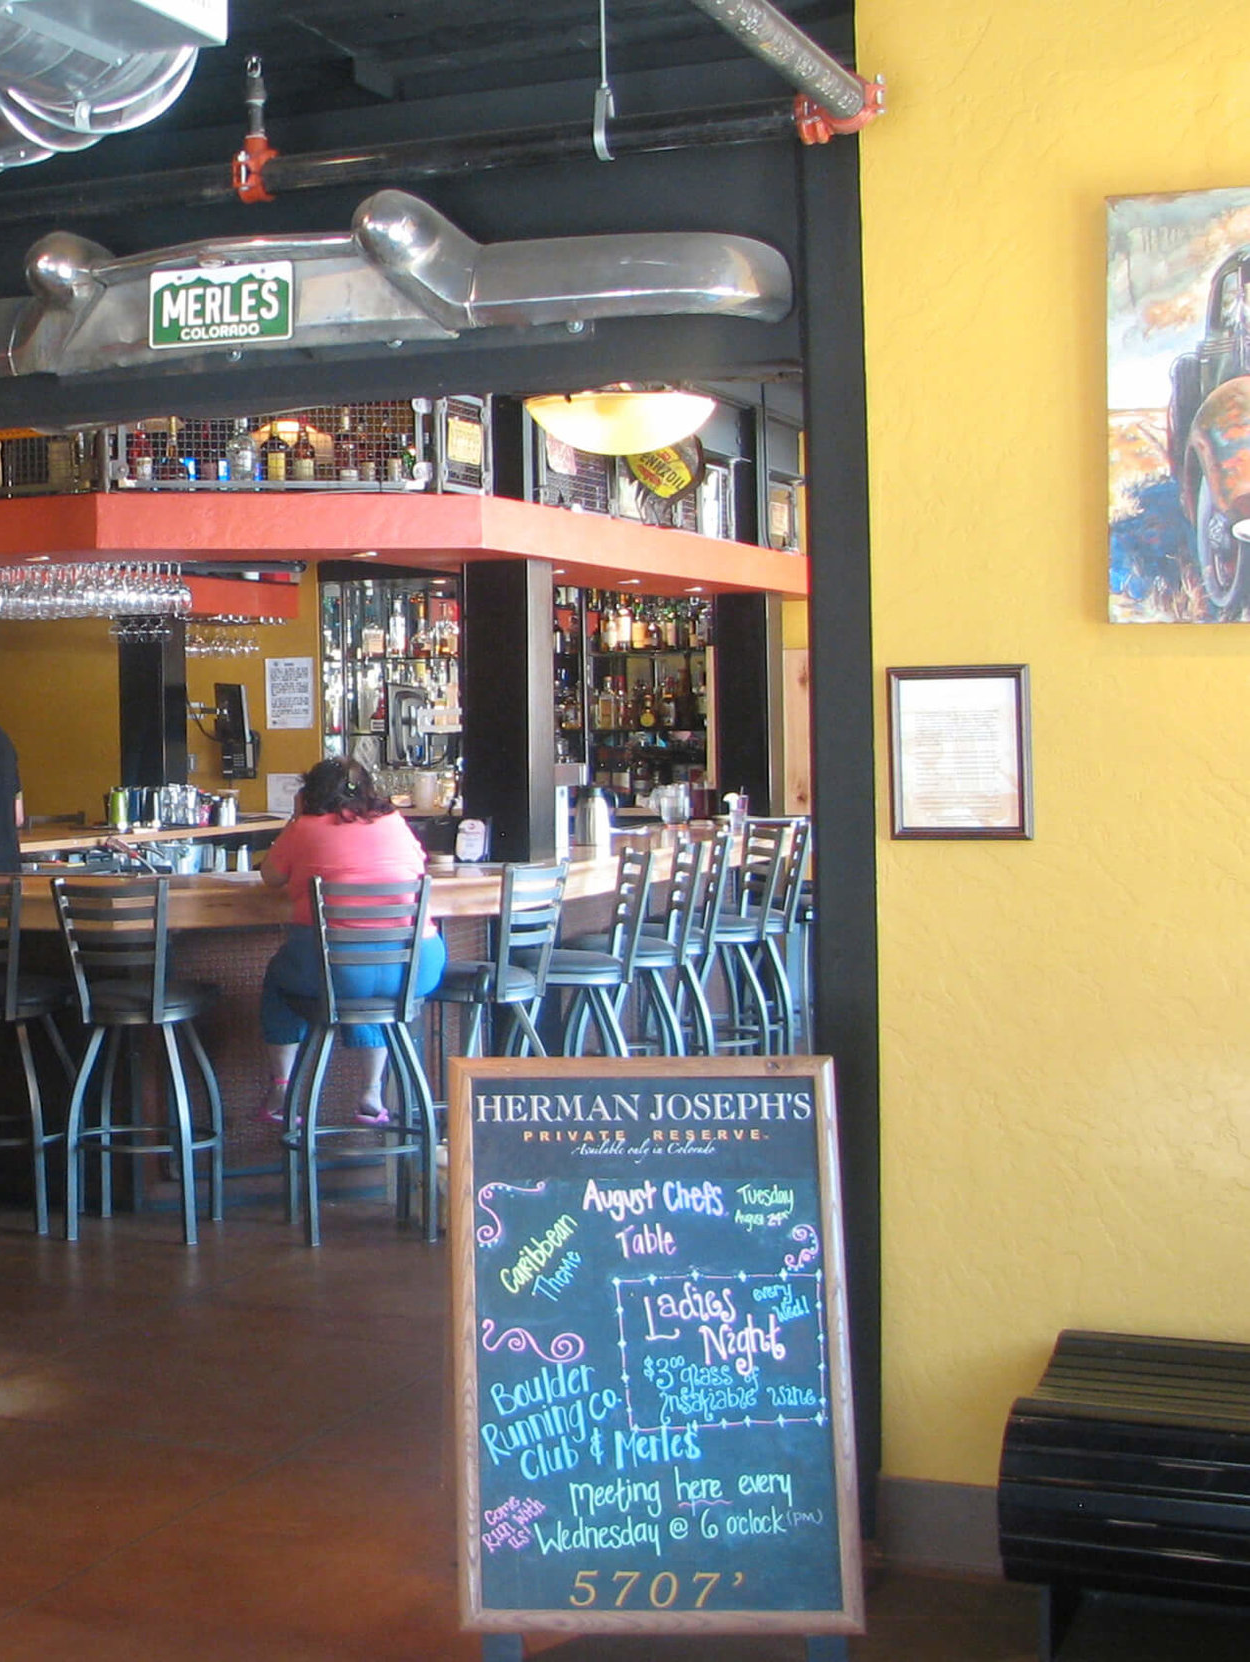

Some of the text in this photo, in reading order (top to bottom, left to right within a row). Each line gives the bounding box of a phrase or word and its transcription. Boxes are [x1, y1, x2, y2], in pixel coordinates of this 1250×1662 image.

[161, 279, 280, 328] MERLES
[180, 322, 261, 341] COLORADO
[476, 1092, 812, 1123] HERMAN JOSEPH'S
[523, 1128, 761, 1142] PRIVATE RESERVE
[571, 1137, 717, 1164] Available only in Colorado
[581, 1178, 658, 1222] August
[735, 1183, 795, 1215] Tuesday
[614, 1222, 678, 1259] Table
[643, 1281, 737, 1342] Ladies
[752, 1283, 794, 1304] every
[698, 1313, 786, 1376] Night
[490, 1362, 596, 1416] Boulder
[680, 1363, 734, 1398] glass
[743, 1365, 760, 1392] of
[766, 1384, 817, 1407] wine
[480, 1399, 587, 1466] Running
[519, 1435, 580, 1481] Club
[568, 1465, 794, 1518] Meeting here every
[533, 1515, 662, 1557] Wednesday
[669, 1517, 689, 1540] @
[701, 1507, 720, 1540] 6
